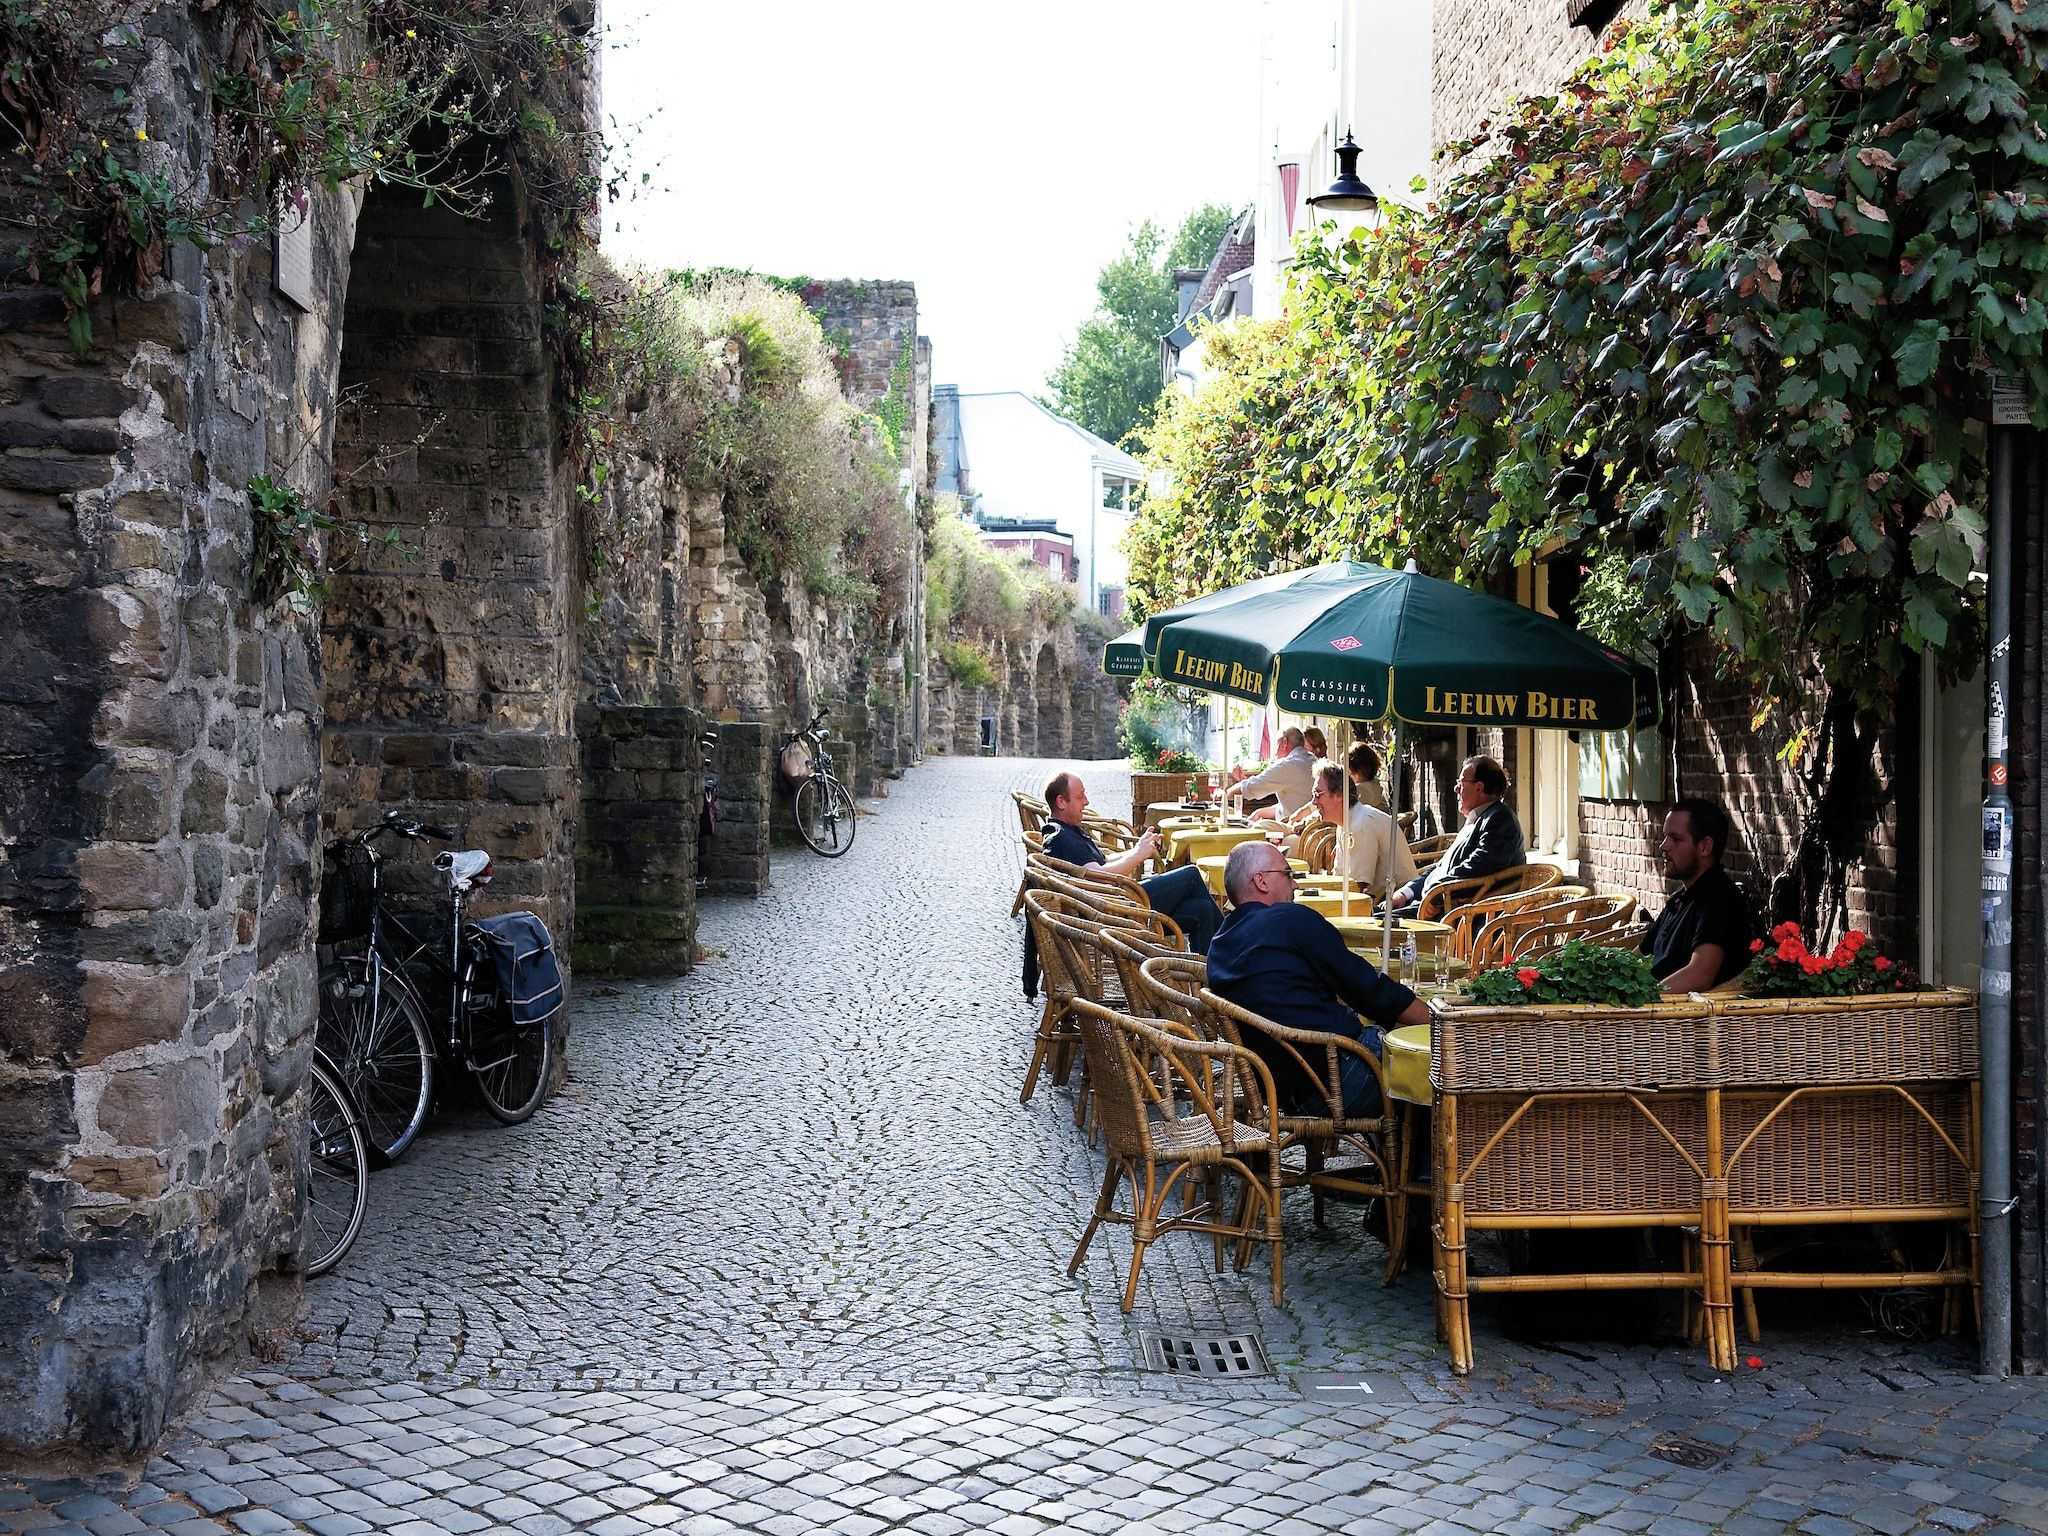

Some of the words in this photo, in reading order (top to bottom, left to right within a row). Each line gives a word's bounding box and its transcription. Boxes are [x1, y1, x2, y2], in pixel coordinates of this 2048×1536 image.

[1173, 649, 1228, 684] LEEUW
[1229, 661, 1263, 695] BIER
[1290, 690, 1374, 707] GEBROUWEN
[1301, 678, 1366, 693] KLASSIEK
[1425, 686, 1519, 716] LEEUW
[1526, 691, 1598, 721] BIER
